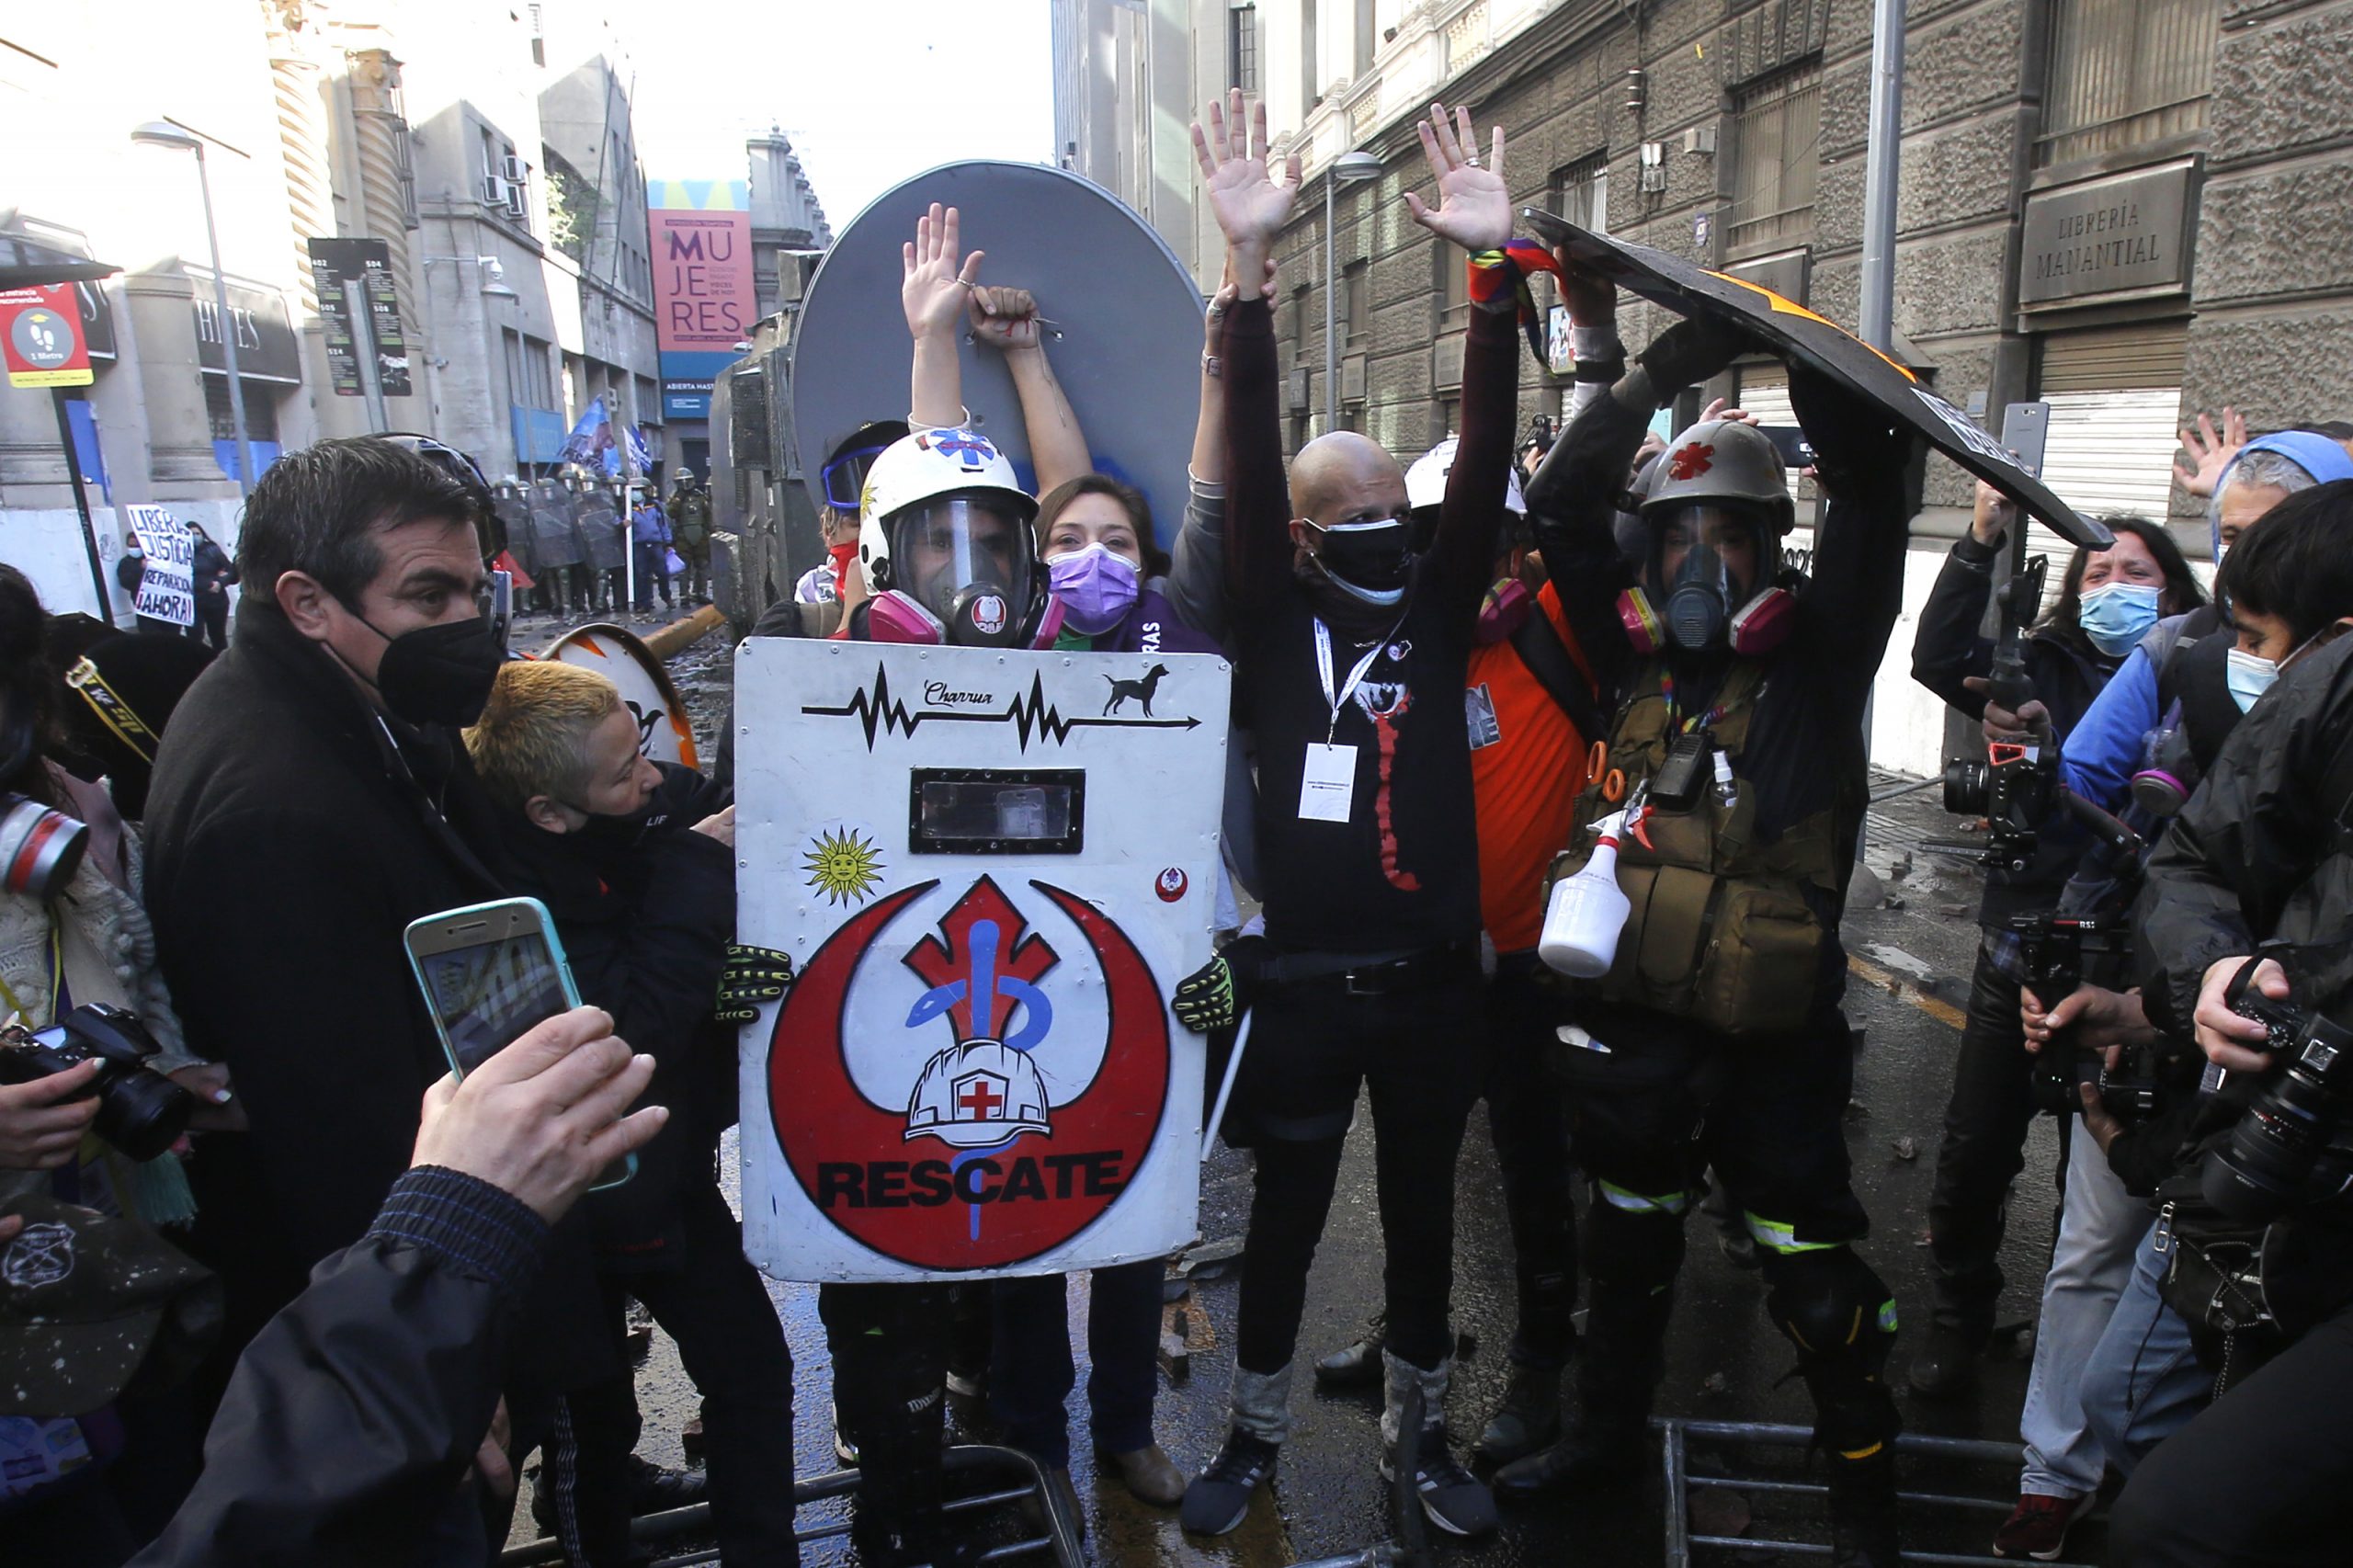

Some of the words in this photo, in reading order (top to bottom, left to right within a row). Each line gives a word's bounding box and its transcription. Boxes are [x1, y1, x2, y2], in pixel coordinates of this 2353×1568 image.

[2058, 199, 2140, 240] LIBRERÍA
[669, 230, 733, 262] MU
[2036, 233, 2160, 280] MANANTIAL
[365, 260, 382, 268] 504
[669, 265, 707, 297] JE
[195, 298, 261, 350] HIES
[671, 301, 741, 333] RES
[139, 533, 193, 567] JUSTICIA
[818, 1150, 1124, 1209] RESCATE
